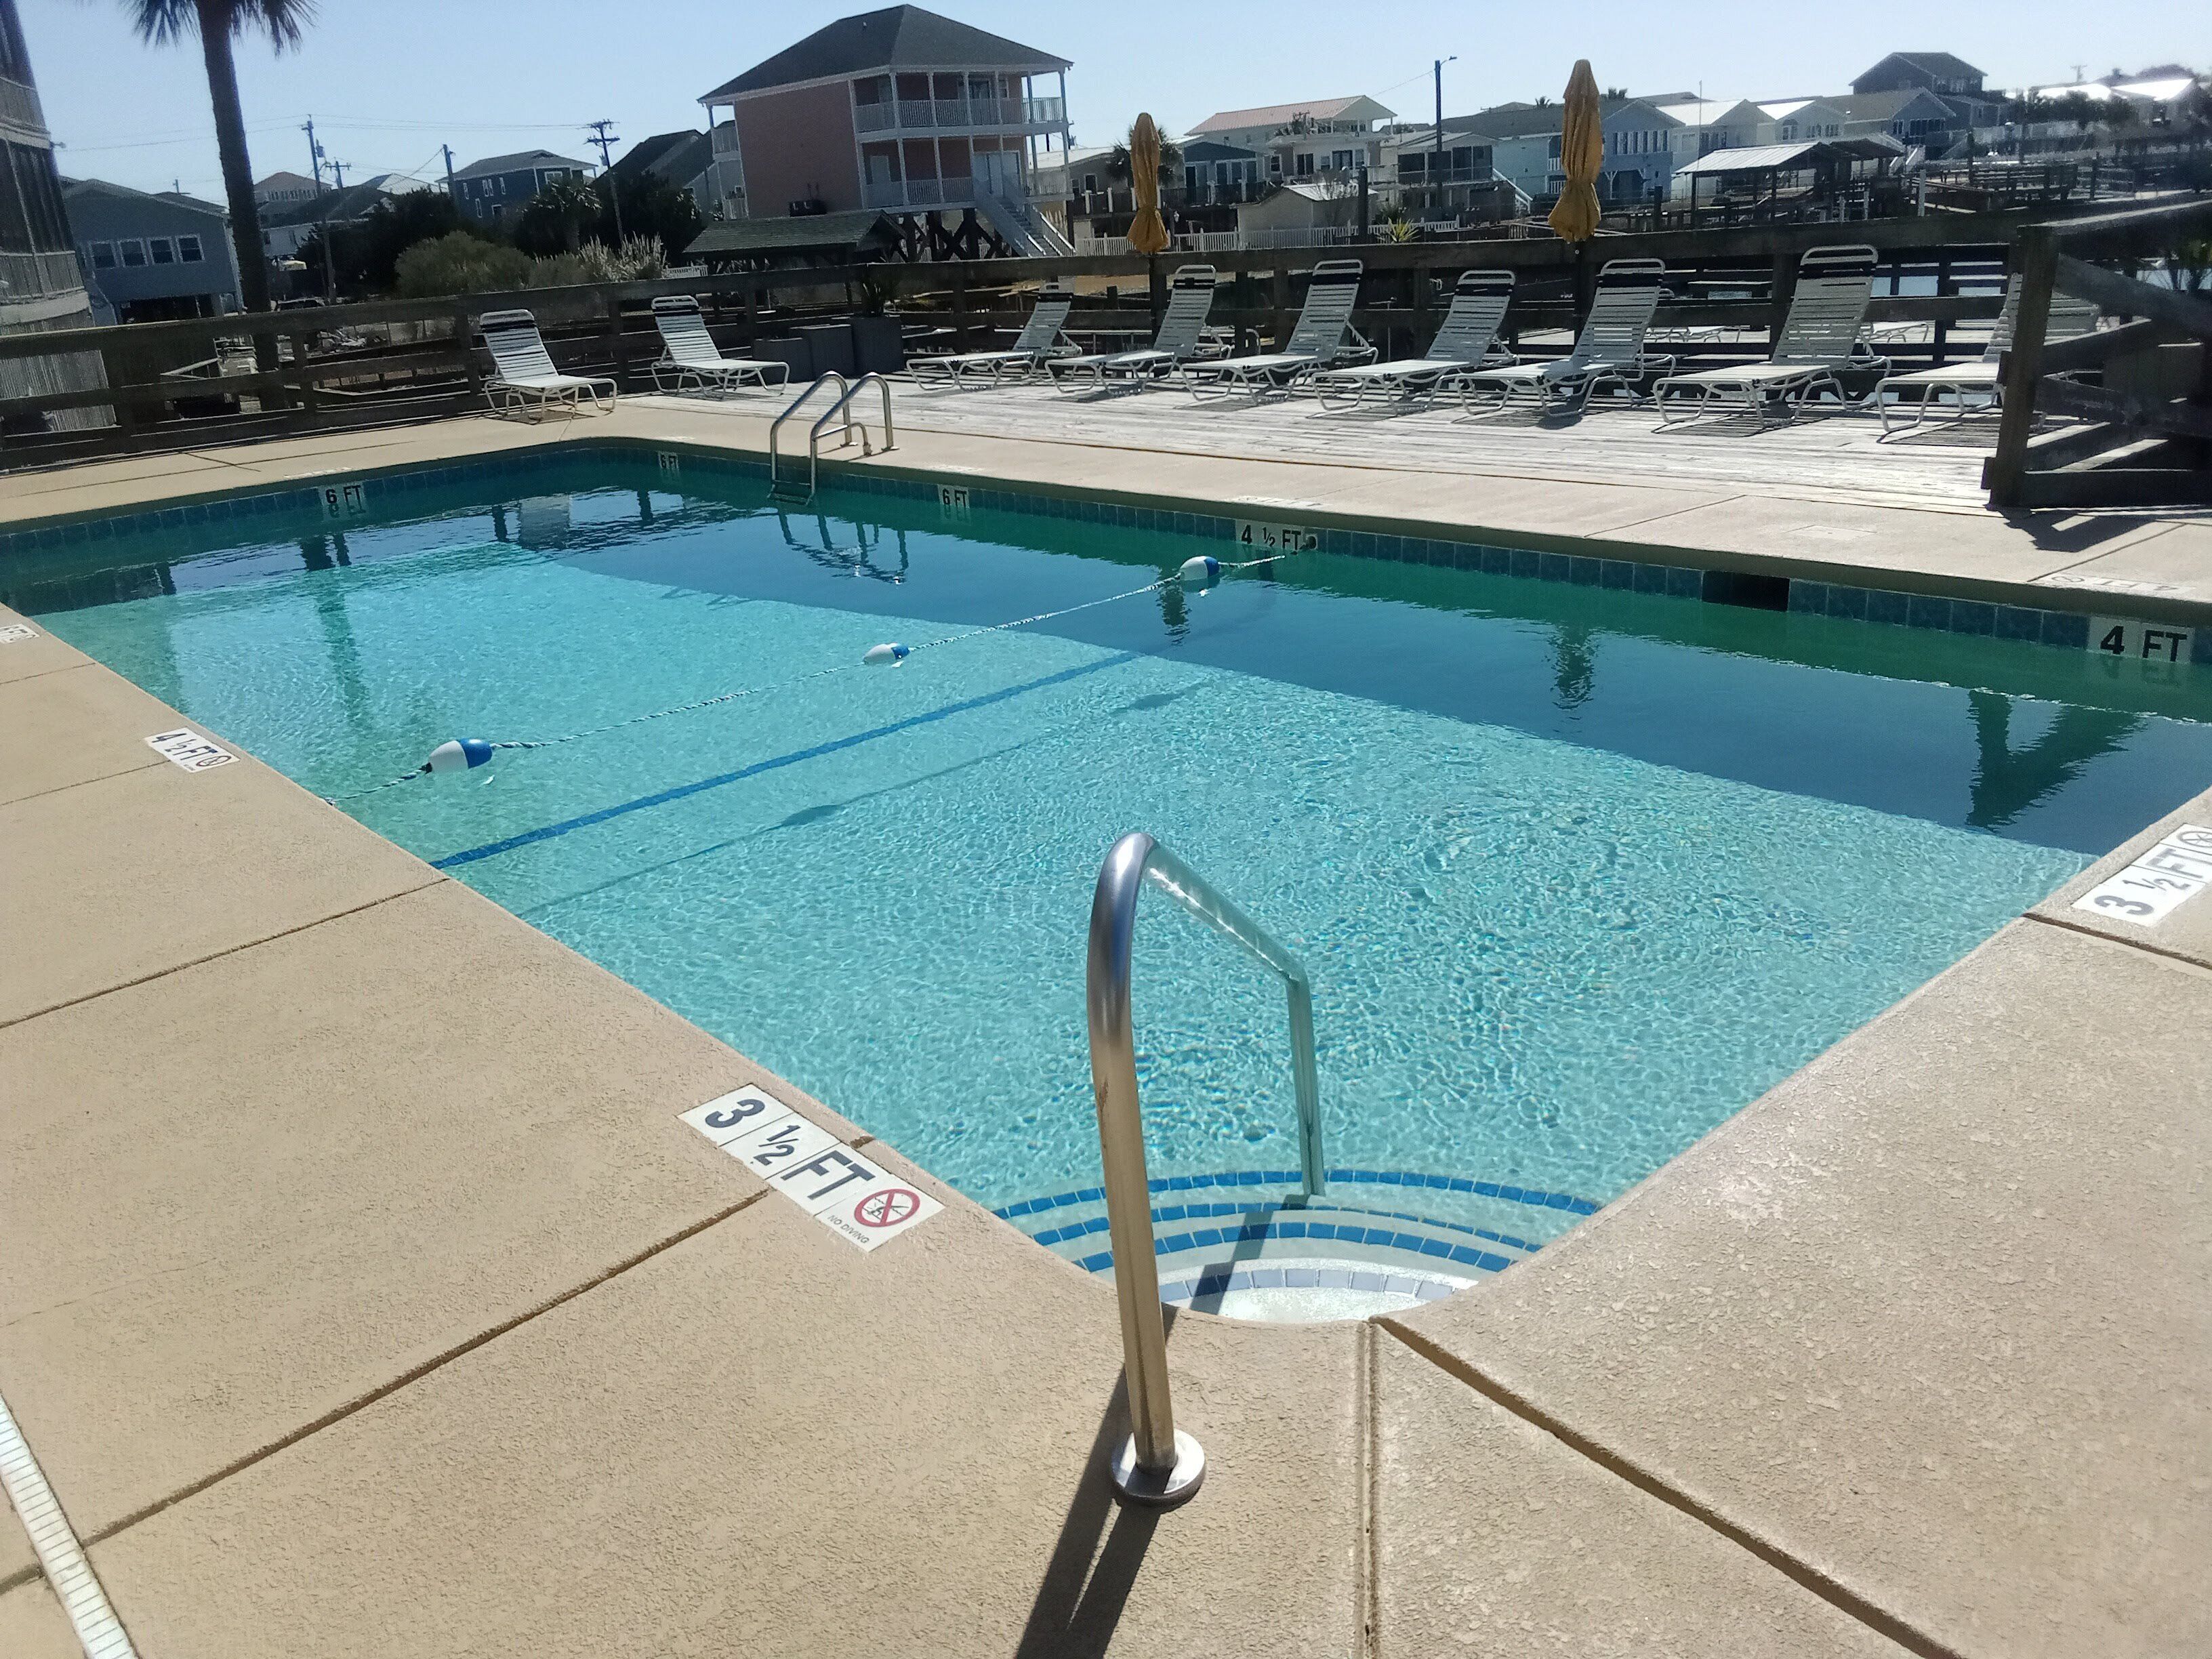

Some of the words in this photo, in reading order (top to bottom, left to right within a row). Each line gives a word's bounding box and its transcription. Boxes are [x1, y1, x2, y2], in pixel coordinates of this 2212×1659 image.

[668, 455, 677, 469] FT
[325, 489, 337, 504] 6
[343, 485, 361, 506] FT
[943, 488, 951, 505] 6
[954, 490, 967, 508] FT
[1241, 525, 1252, 544] 4
[1282, 529, 1301, 550] FT
[2100, 626, 2125, 655] 4
[2142, 630, 2188, 661] FT
[151, 733, 187, 743] 4
[172, 745, 218, 760] FT
[2094, 895, 2154, 916] 3
[2146, 847, 2212, 879] FT
[705, 1099, 766, 1128] 3
[780, 1150, 876, 1201] FT
[827, 1214, 842, 1225] NO
[840, 1223, 870, 1244] DIVING
